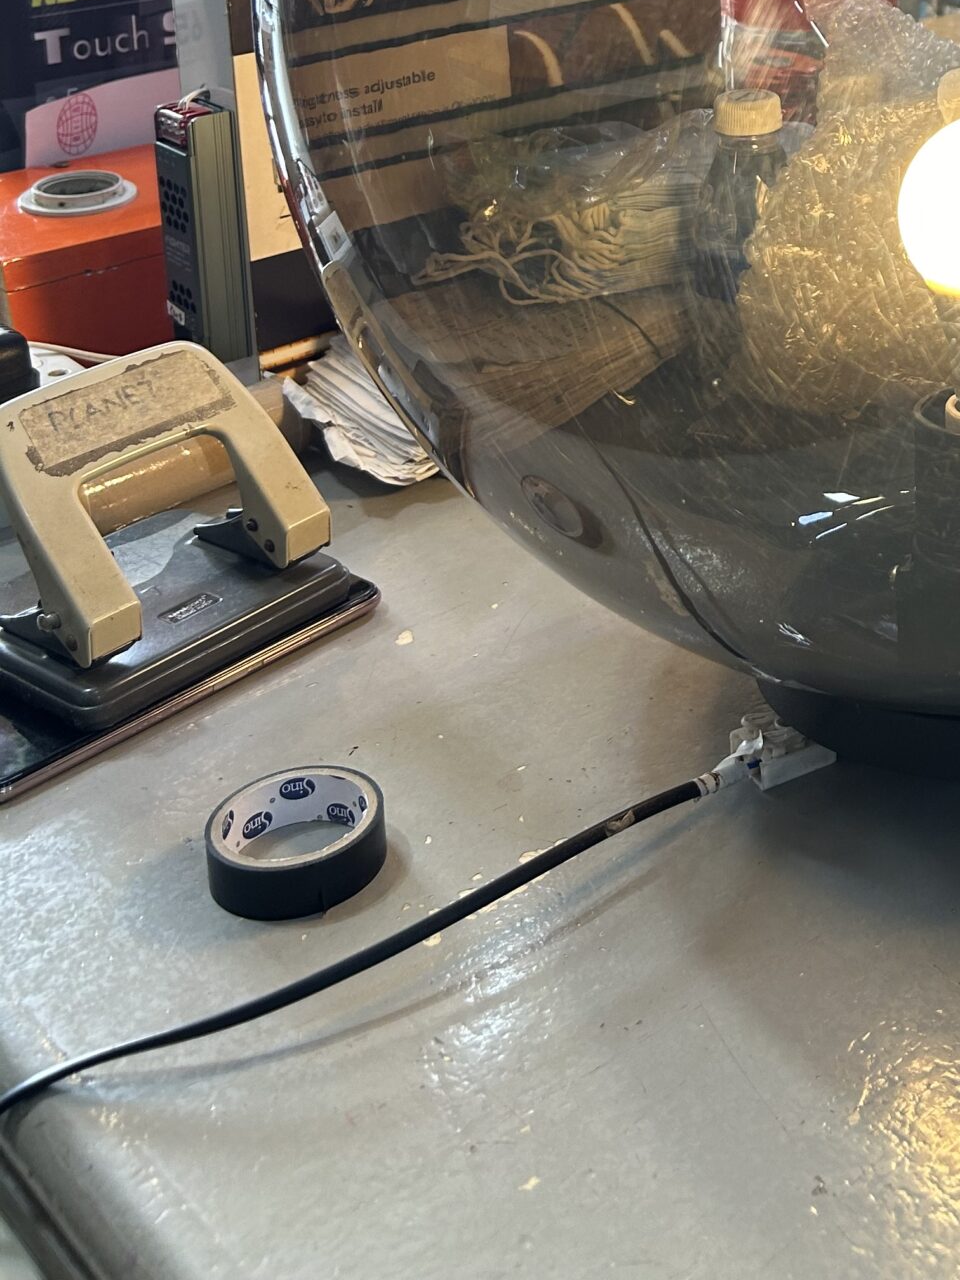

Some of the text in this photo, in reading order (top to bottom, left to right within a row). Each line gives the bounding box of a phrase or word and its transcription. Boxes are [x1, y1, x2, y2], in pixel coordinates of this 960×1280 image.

[34, 14, 149, 65] Touch
[364, 69, 436, 95] adjustable
[281, 777, 314, 796] Sino
[244, 811, 273, 835] Sino
